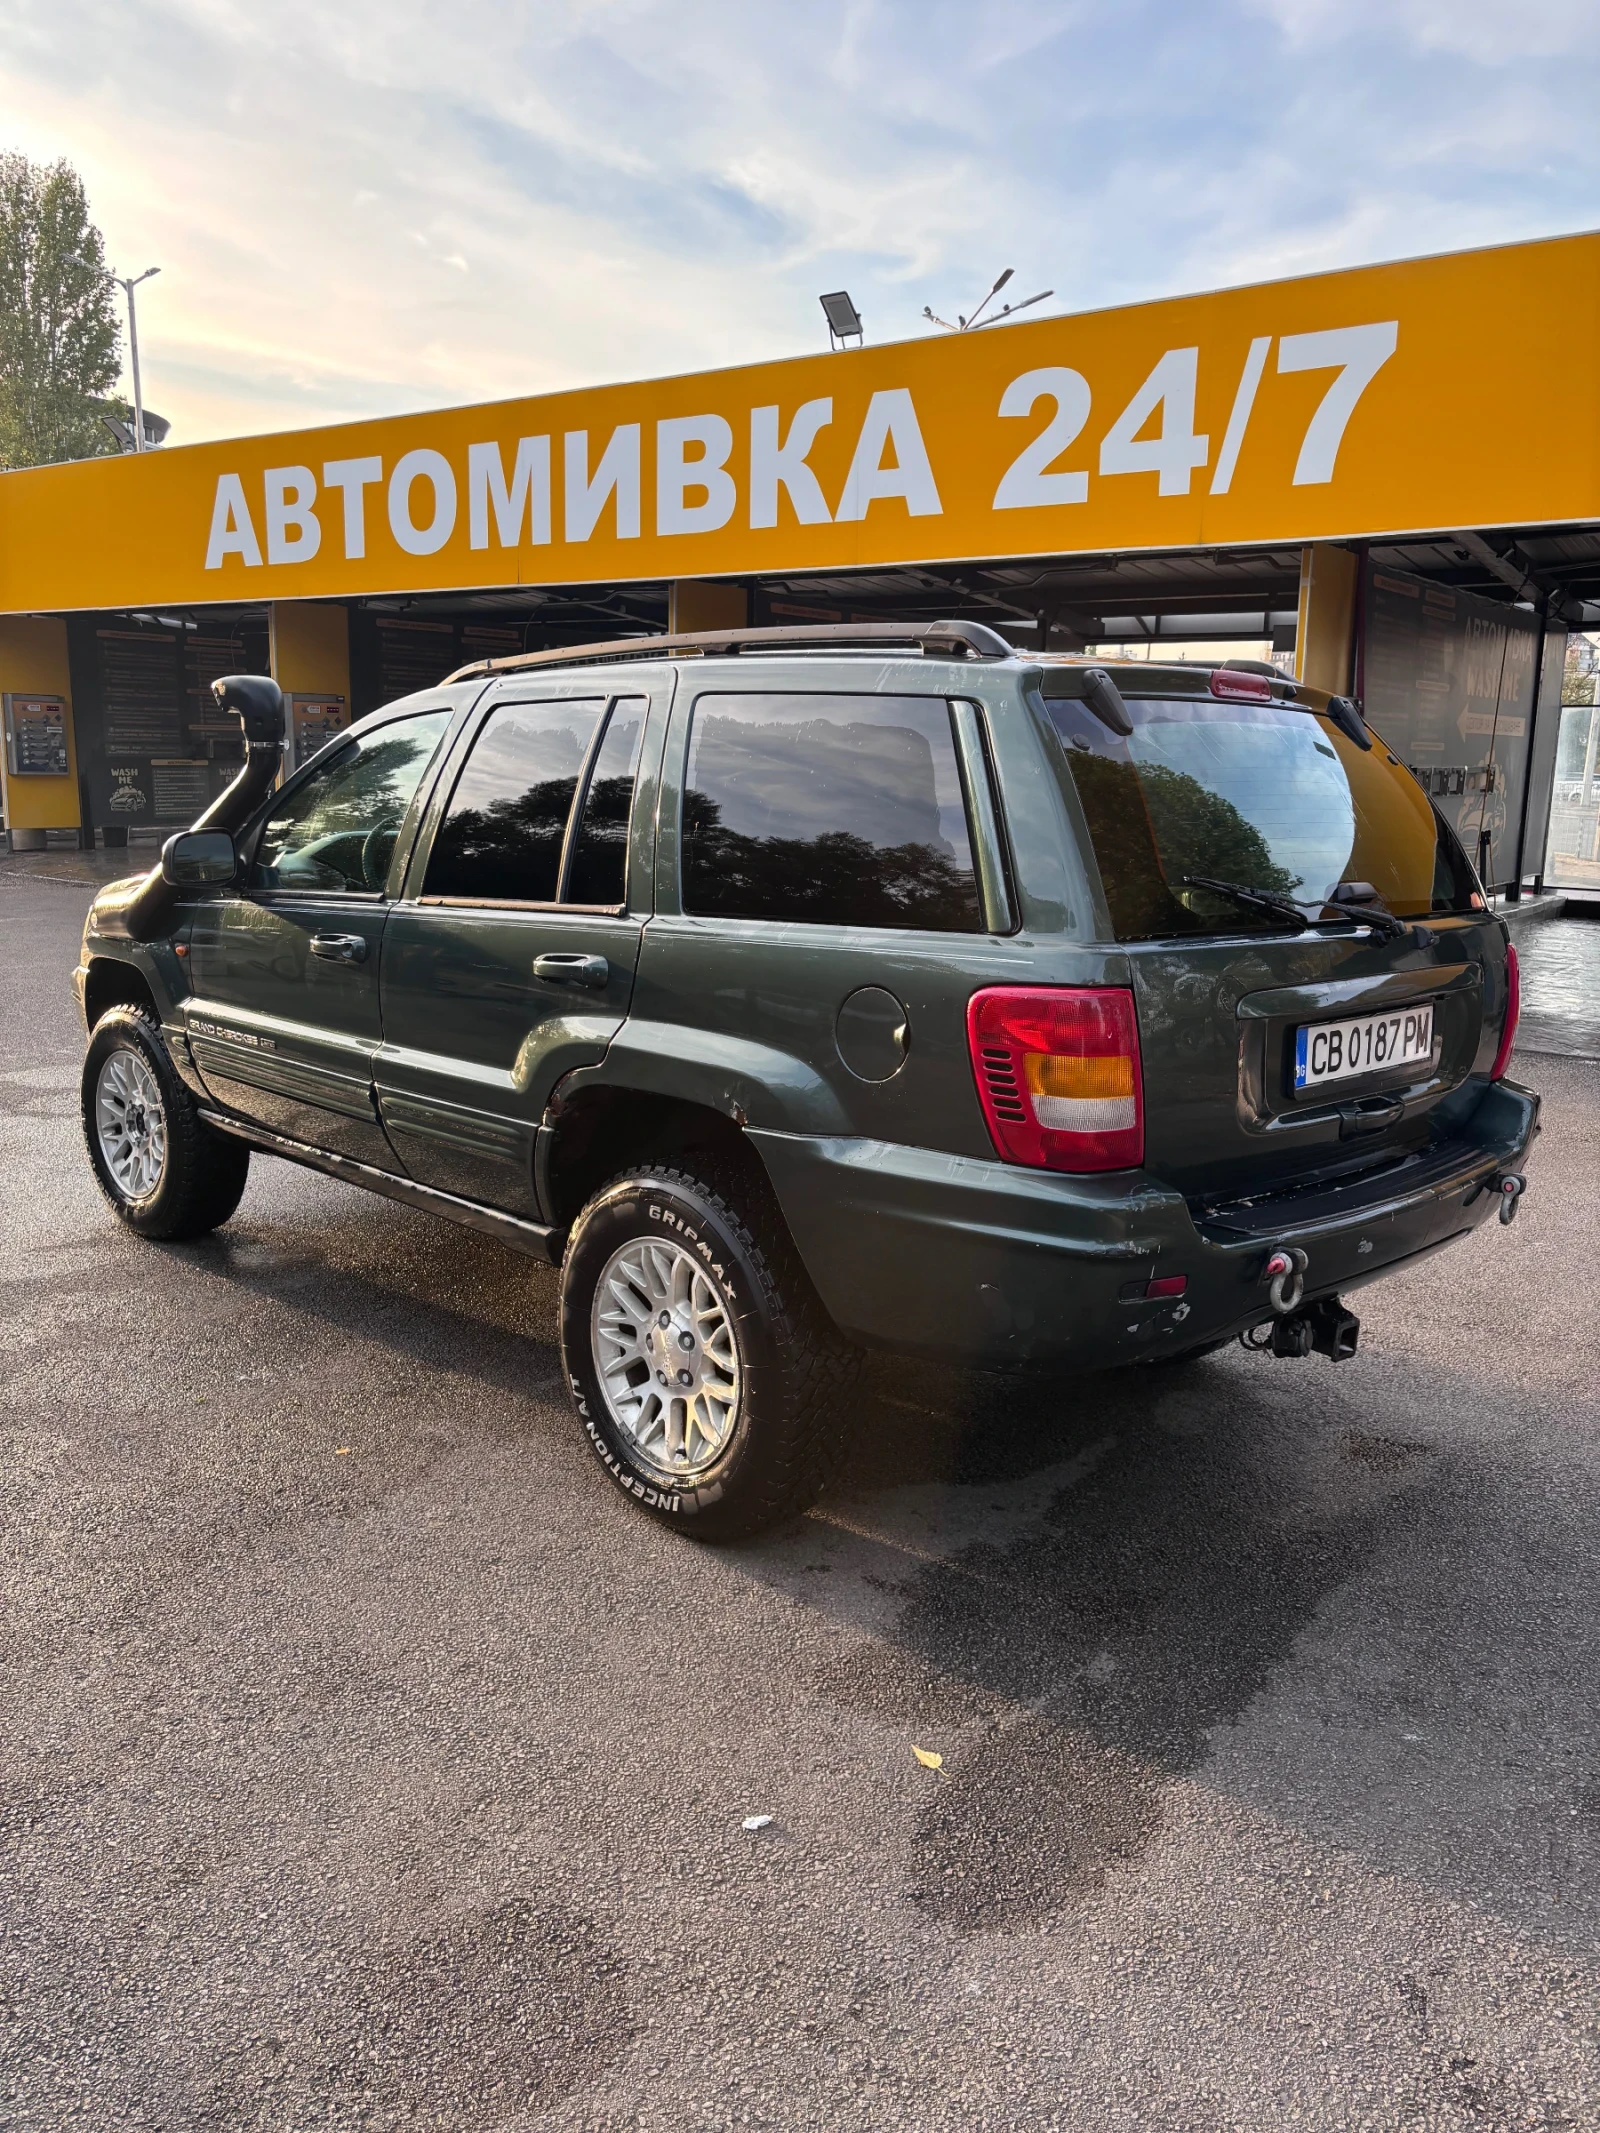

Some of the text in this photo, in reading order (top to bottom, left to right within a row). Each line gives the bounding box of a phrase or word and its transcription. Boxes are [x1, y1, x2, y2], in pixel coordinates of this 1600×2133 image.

[205, 320, 1399, 570] АВТОМИВКА 24/7
[1466, 666, 1521, 702] WASH ME
[110, 768, 139, 777] WASH
[118, 776, 133, 785] ME
[189, 1018, 215, 1035] GRAND
[216, 1026, 258, 1046] CHEROKEE
[1311, 1012, 1431, 1076] CB 0187 PM
[648, 1204, 737, 1301] GRIPMAX
[585, 1420, 680, 1512] INCEPTION
